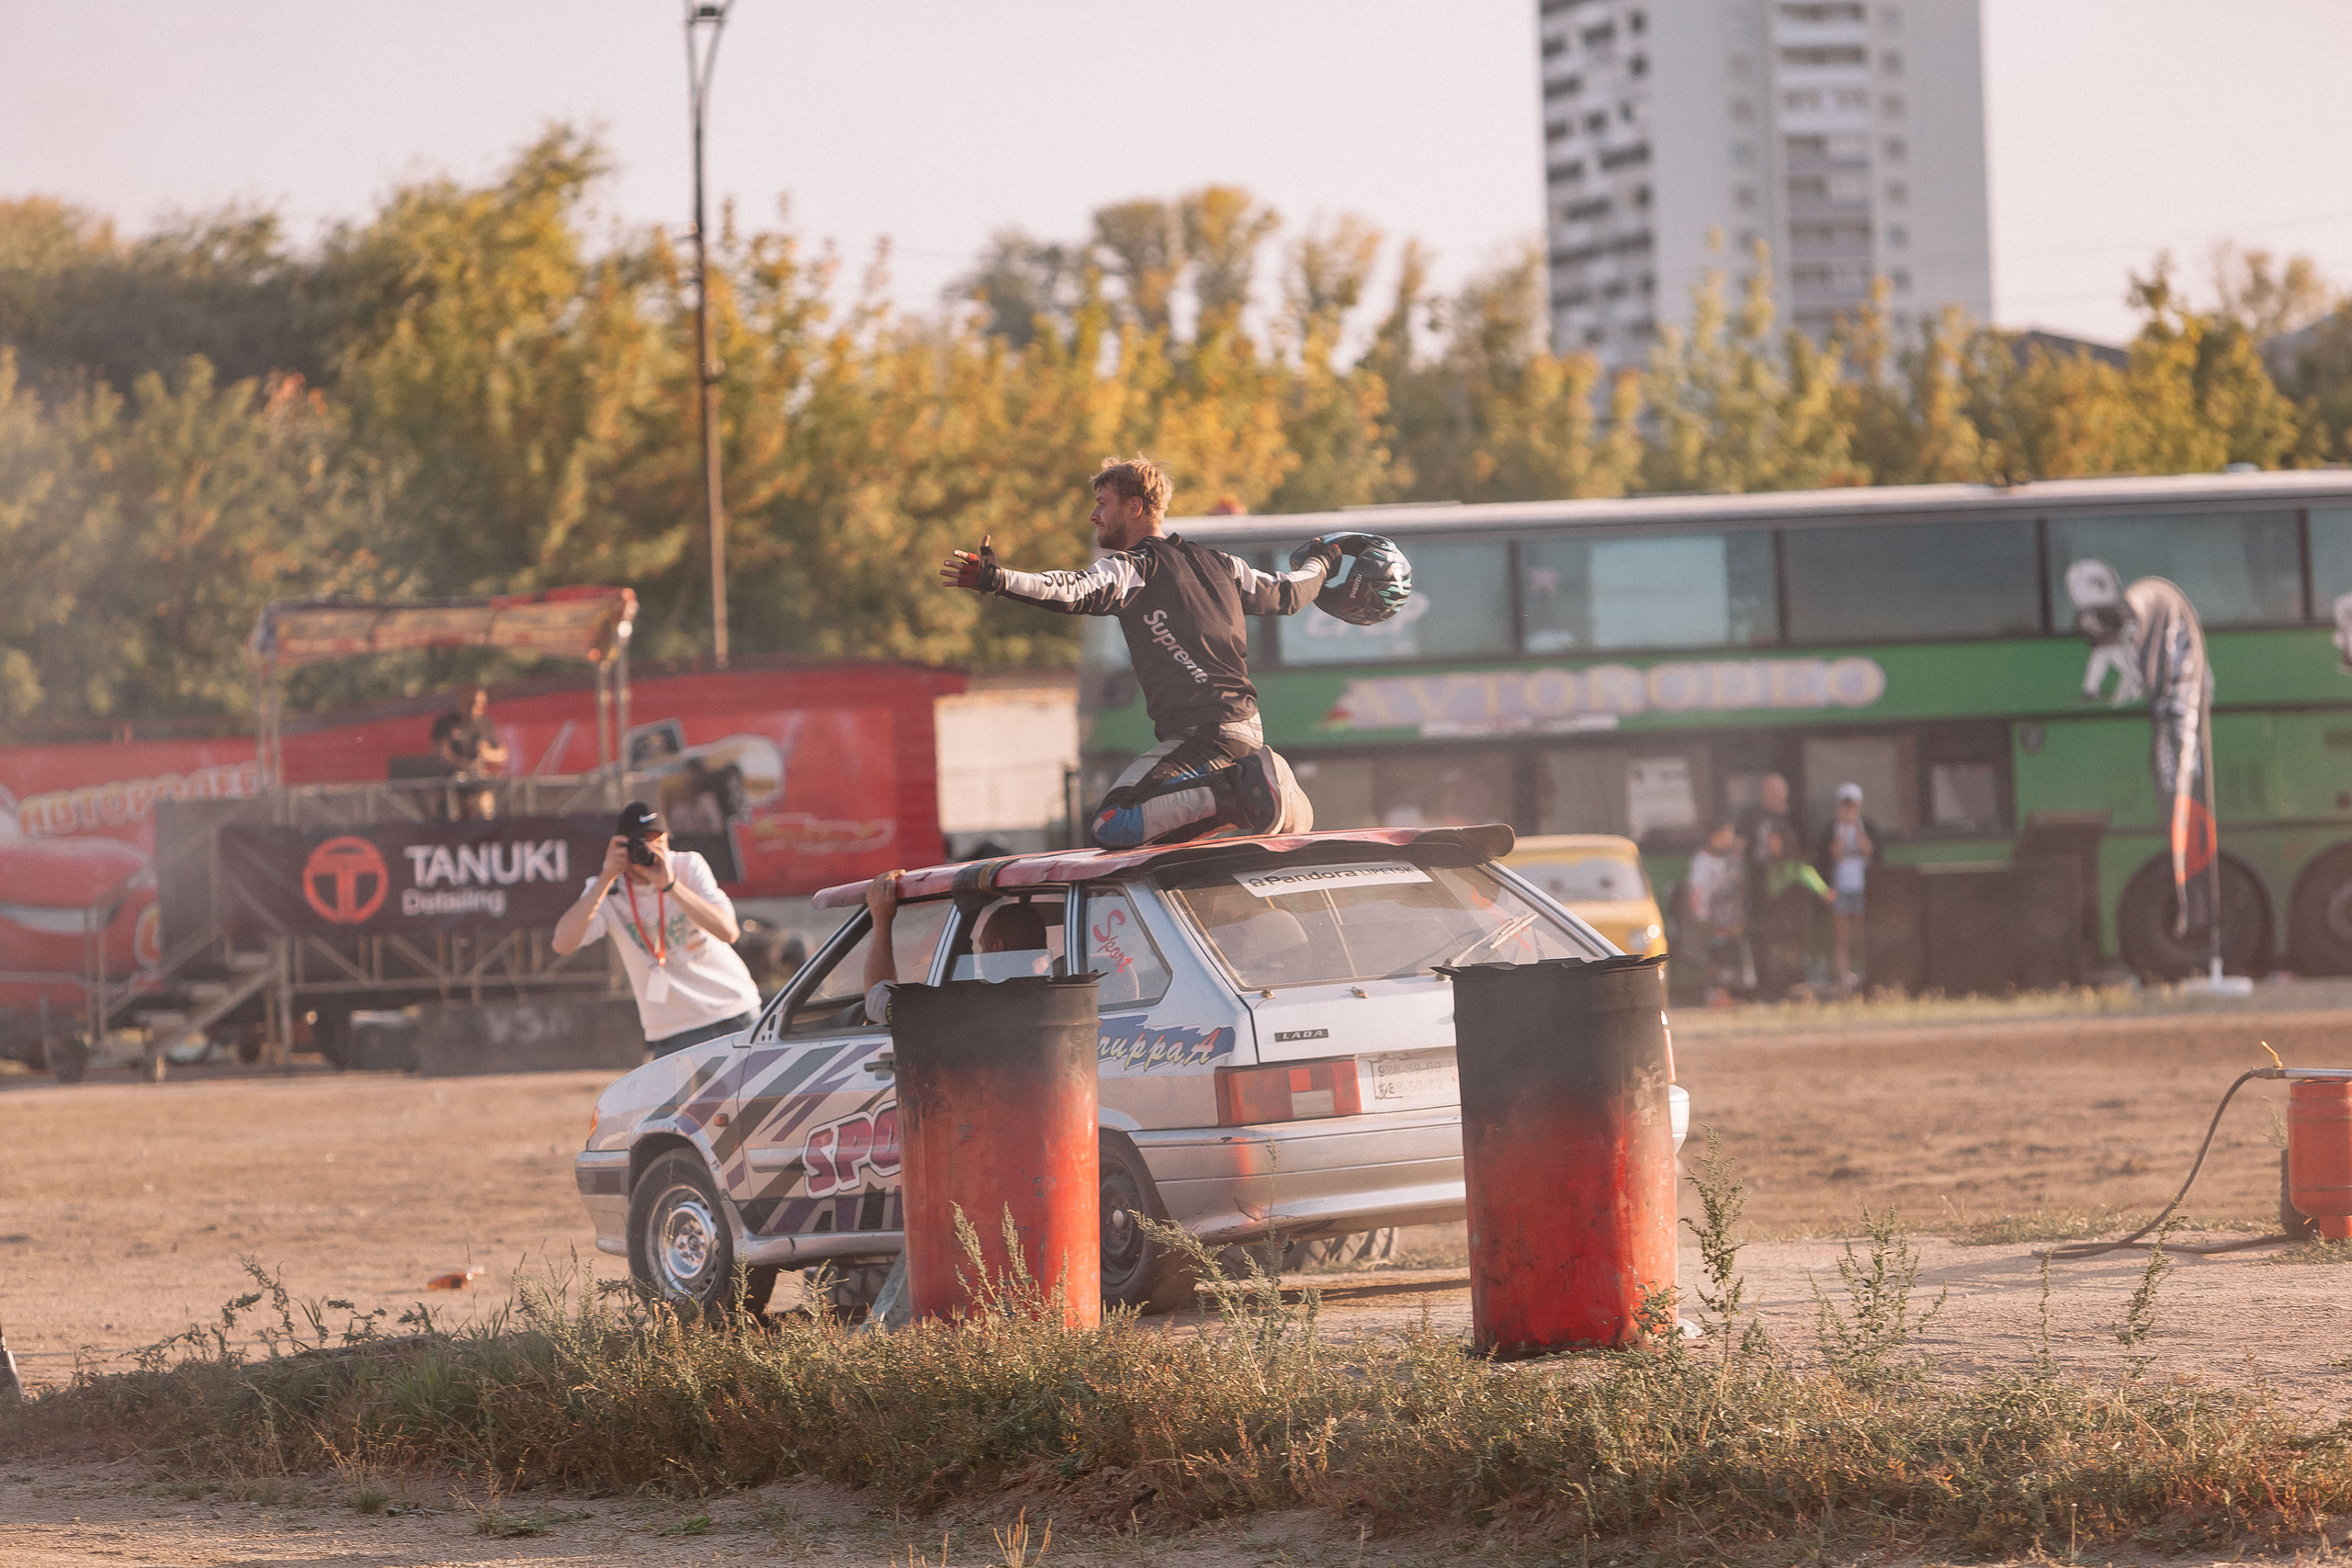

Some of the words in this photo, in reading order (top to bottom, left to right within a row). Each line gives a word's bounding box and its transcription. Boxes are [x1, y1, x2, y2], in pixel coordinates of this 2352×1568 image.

[1143, 609, 1208, 683] Supreme
[403, 838, 569, 888] TANUKI
[1263, 870, 1358, 886] Pandora
[1358, 866, 1417, 876] LIPETSK
[1282, 1030, 1323, 1040] LADA
